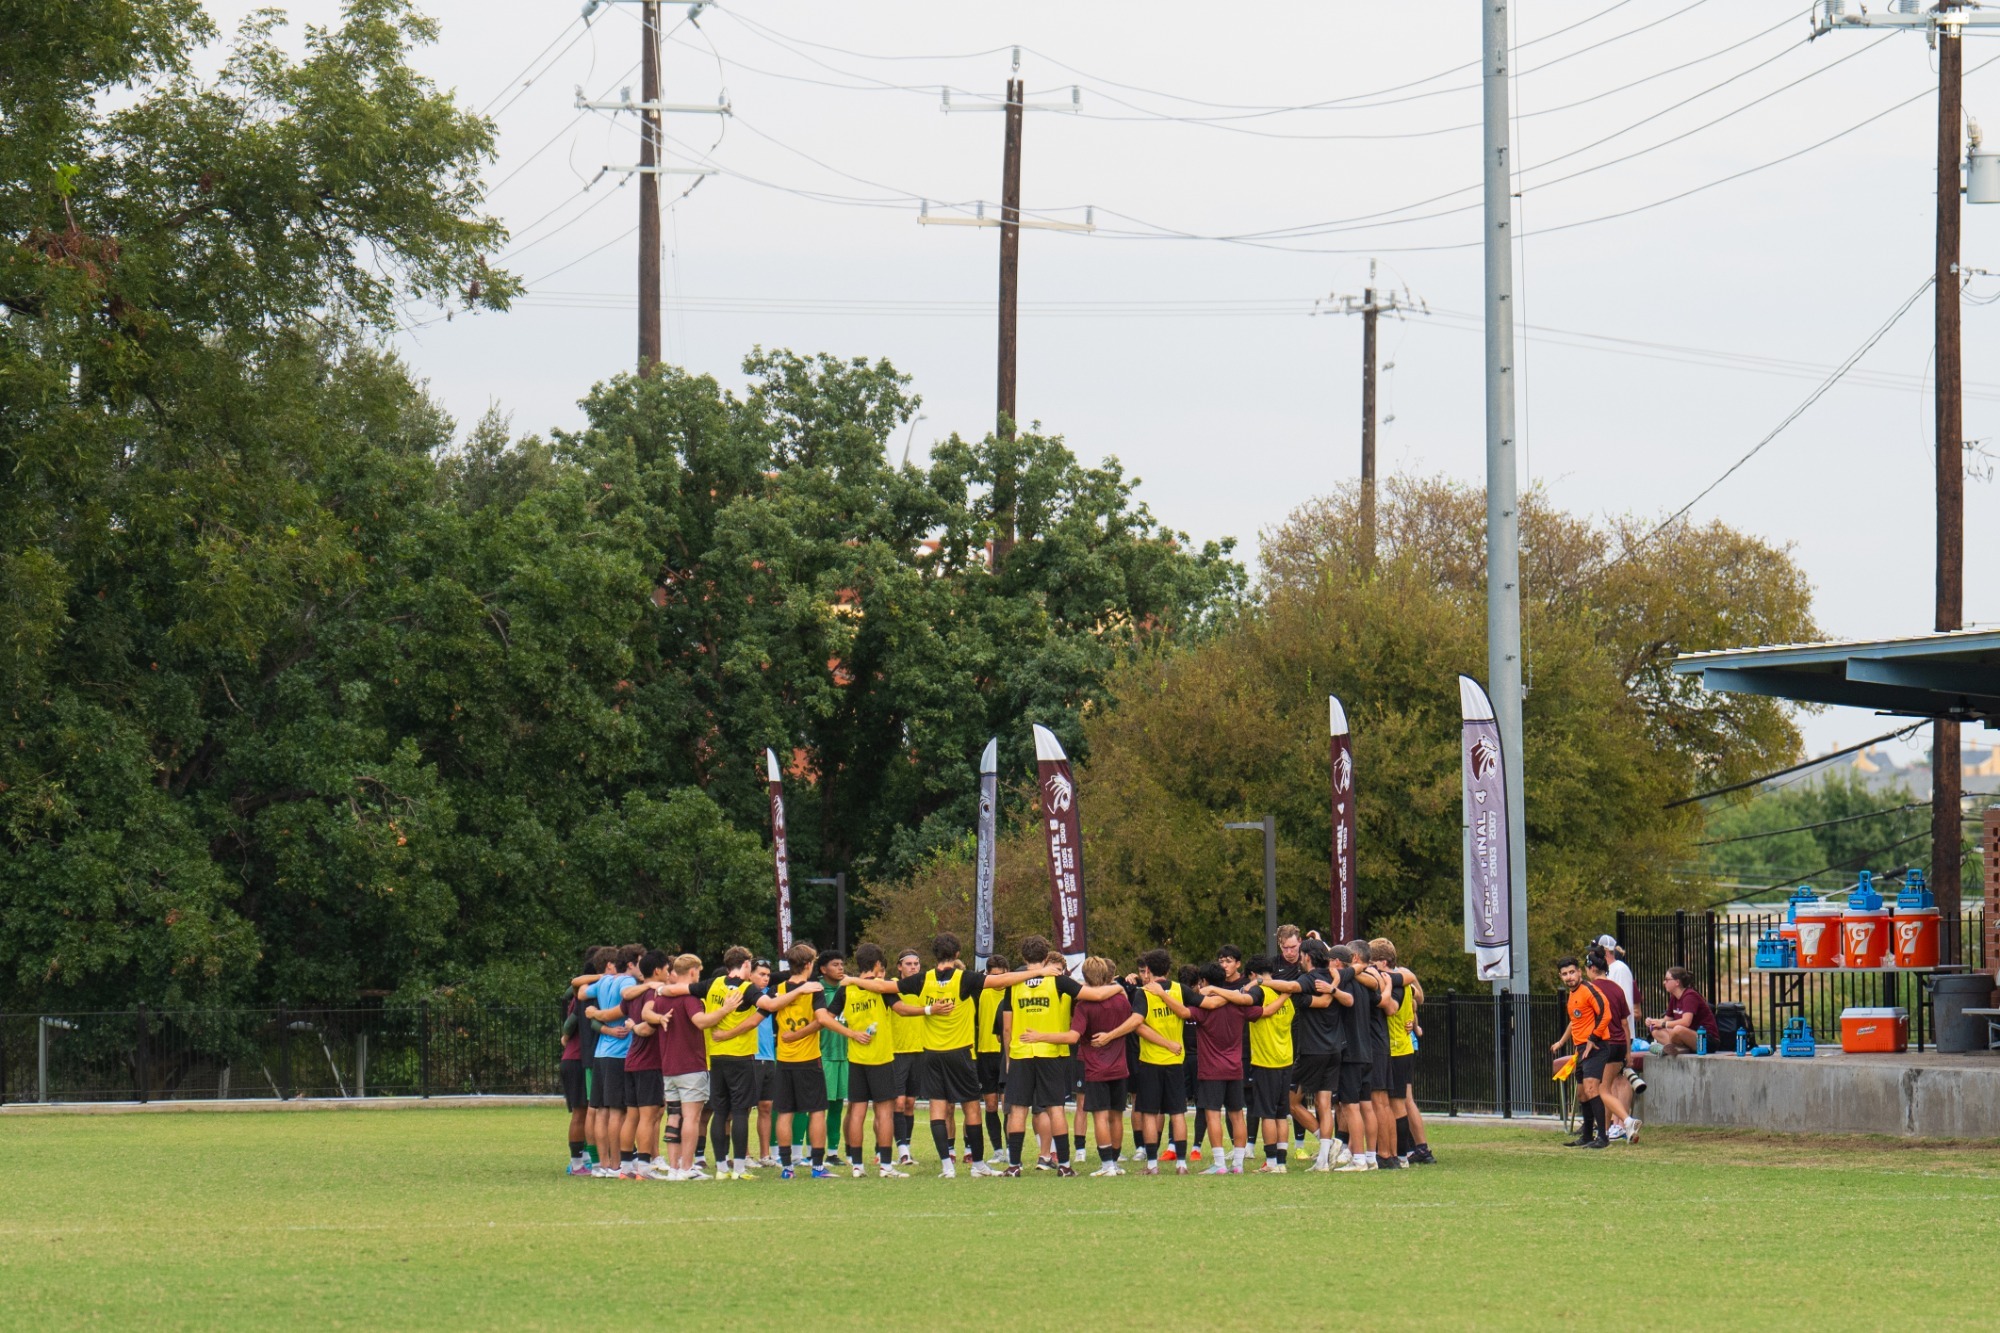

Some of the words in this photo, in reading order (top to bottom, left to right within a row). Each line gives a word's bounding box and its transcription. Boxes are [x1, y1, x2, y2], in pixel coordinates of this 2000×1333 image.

[1337, 802, 1344, 814] 4
[1475, 790, 1488, 804] 4
[1488, 810, 1498, 840] 2007
[1476, 811, 1488, 868] FINAL
[1489, 846, 1498, 878] 2003
[1490, 884, 1500, 914] 2002
[851, 998, 876, 1013] TRINITY
[1018, 997, 1050, 1009] UMHB
